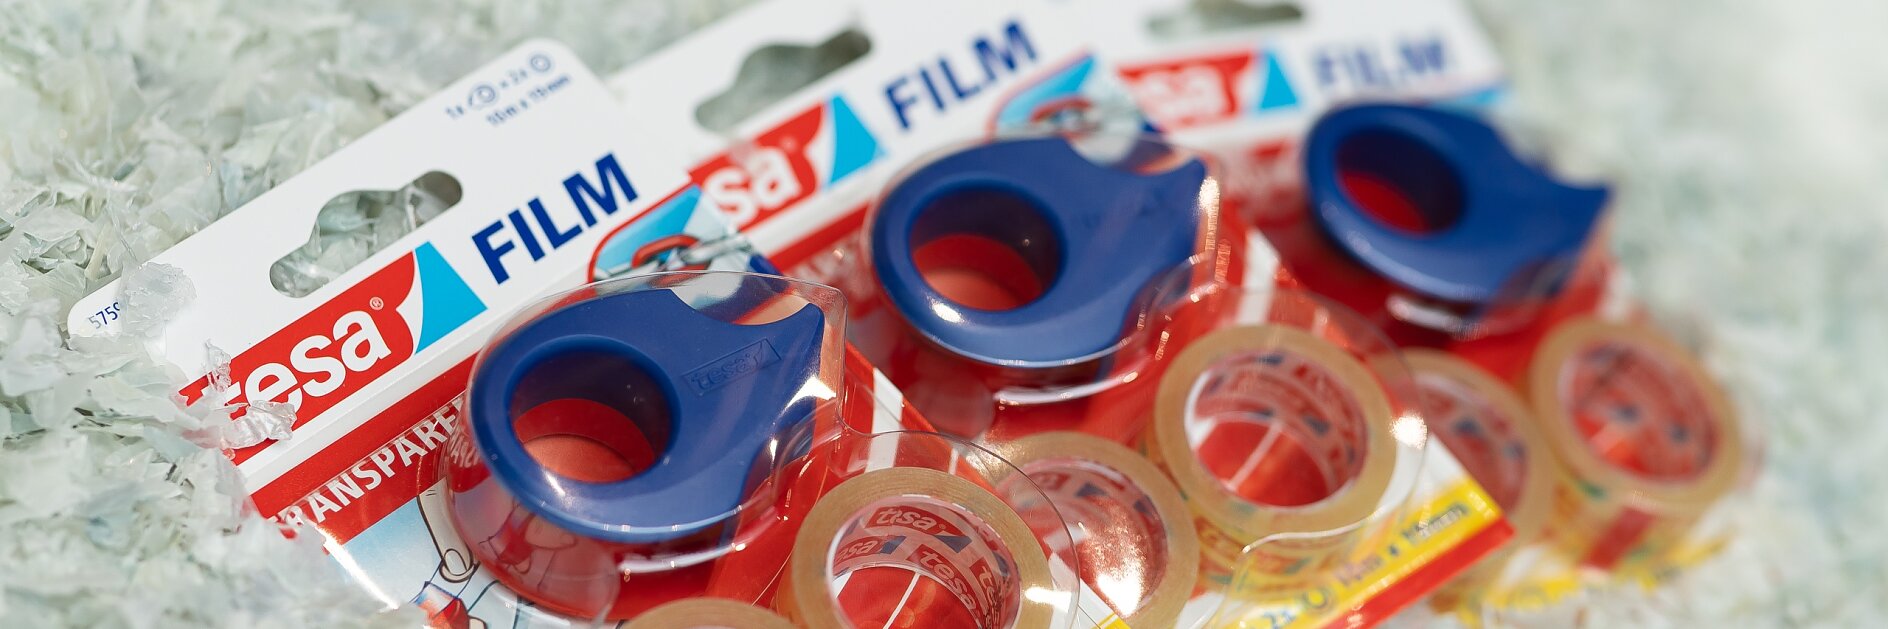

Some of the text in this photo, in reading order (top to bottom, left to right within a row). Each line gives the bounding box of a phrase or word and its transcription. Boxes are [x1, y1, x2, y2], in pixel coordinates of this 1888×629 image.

[884, 22, 1037, 130] FILM
[1314, 38, 1448, 88] FILM
[472, 153, 638, 285] FILM
[703, 146, 802, 223] sa
